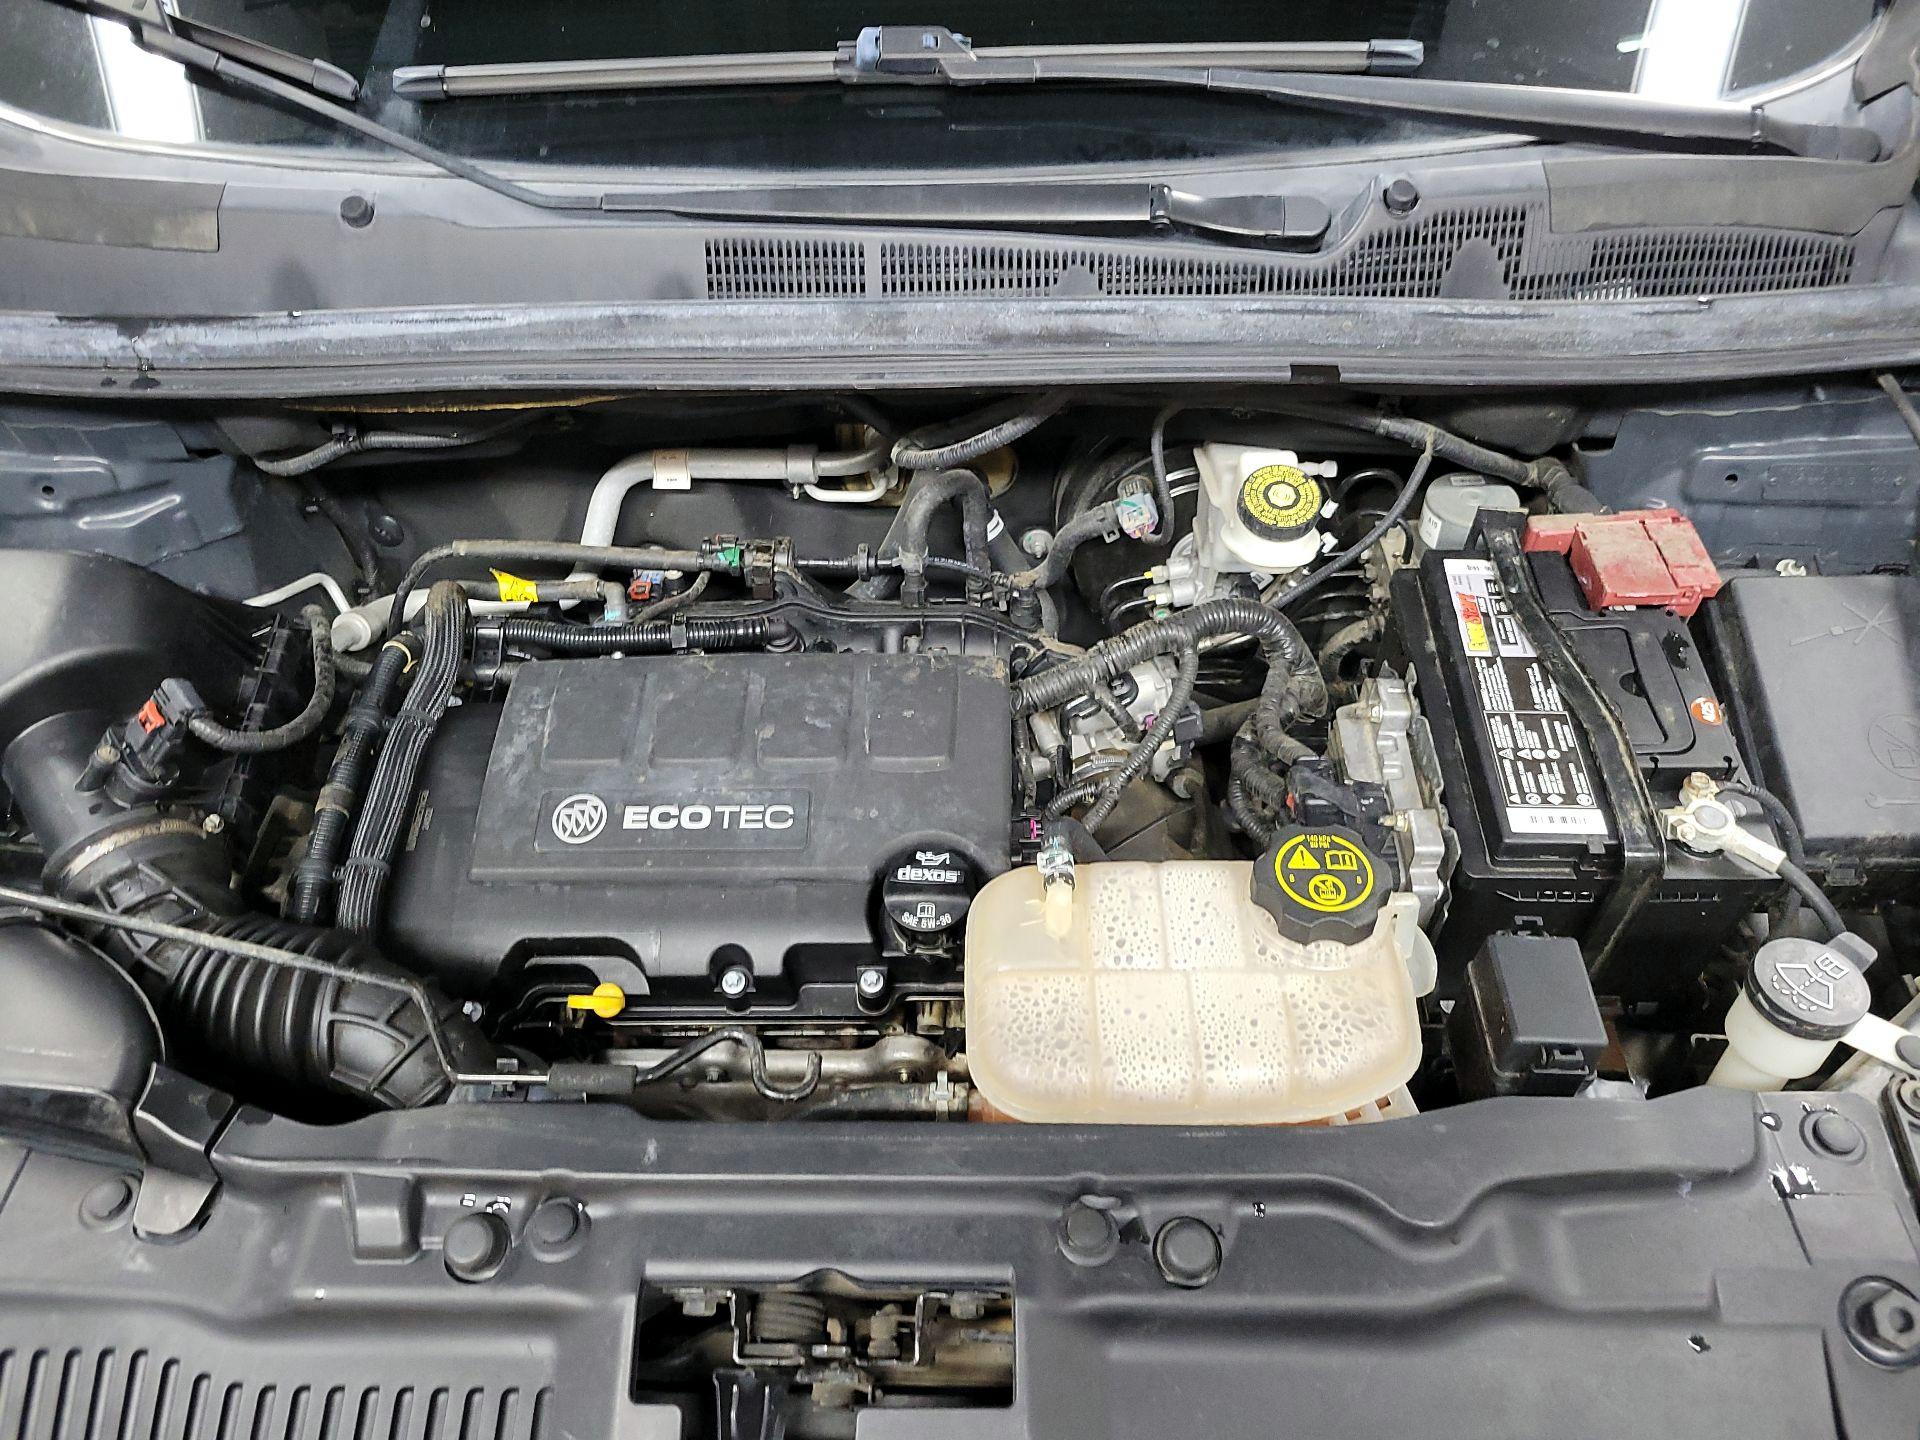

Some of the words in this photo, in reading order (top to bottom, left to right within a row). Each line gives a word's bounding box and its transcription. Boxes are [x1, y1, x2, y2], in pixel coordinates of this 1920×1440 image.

[622, 804, 795, 830] ECOTEC
[897, 864, 958, 883] dexos
[901, 911, 919, 928] SAE
